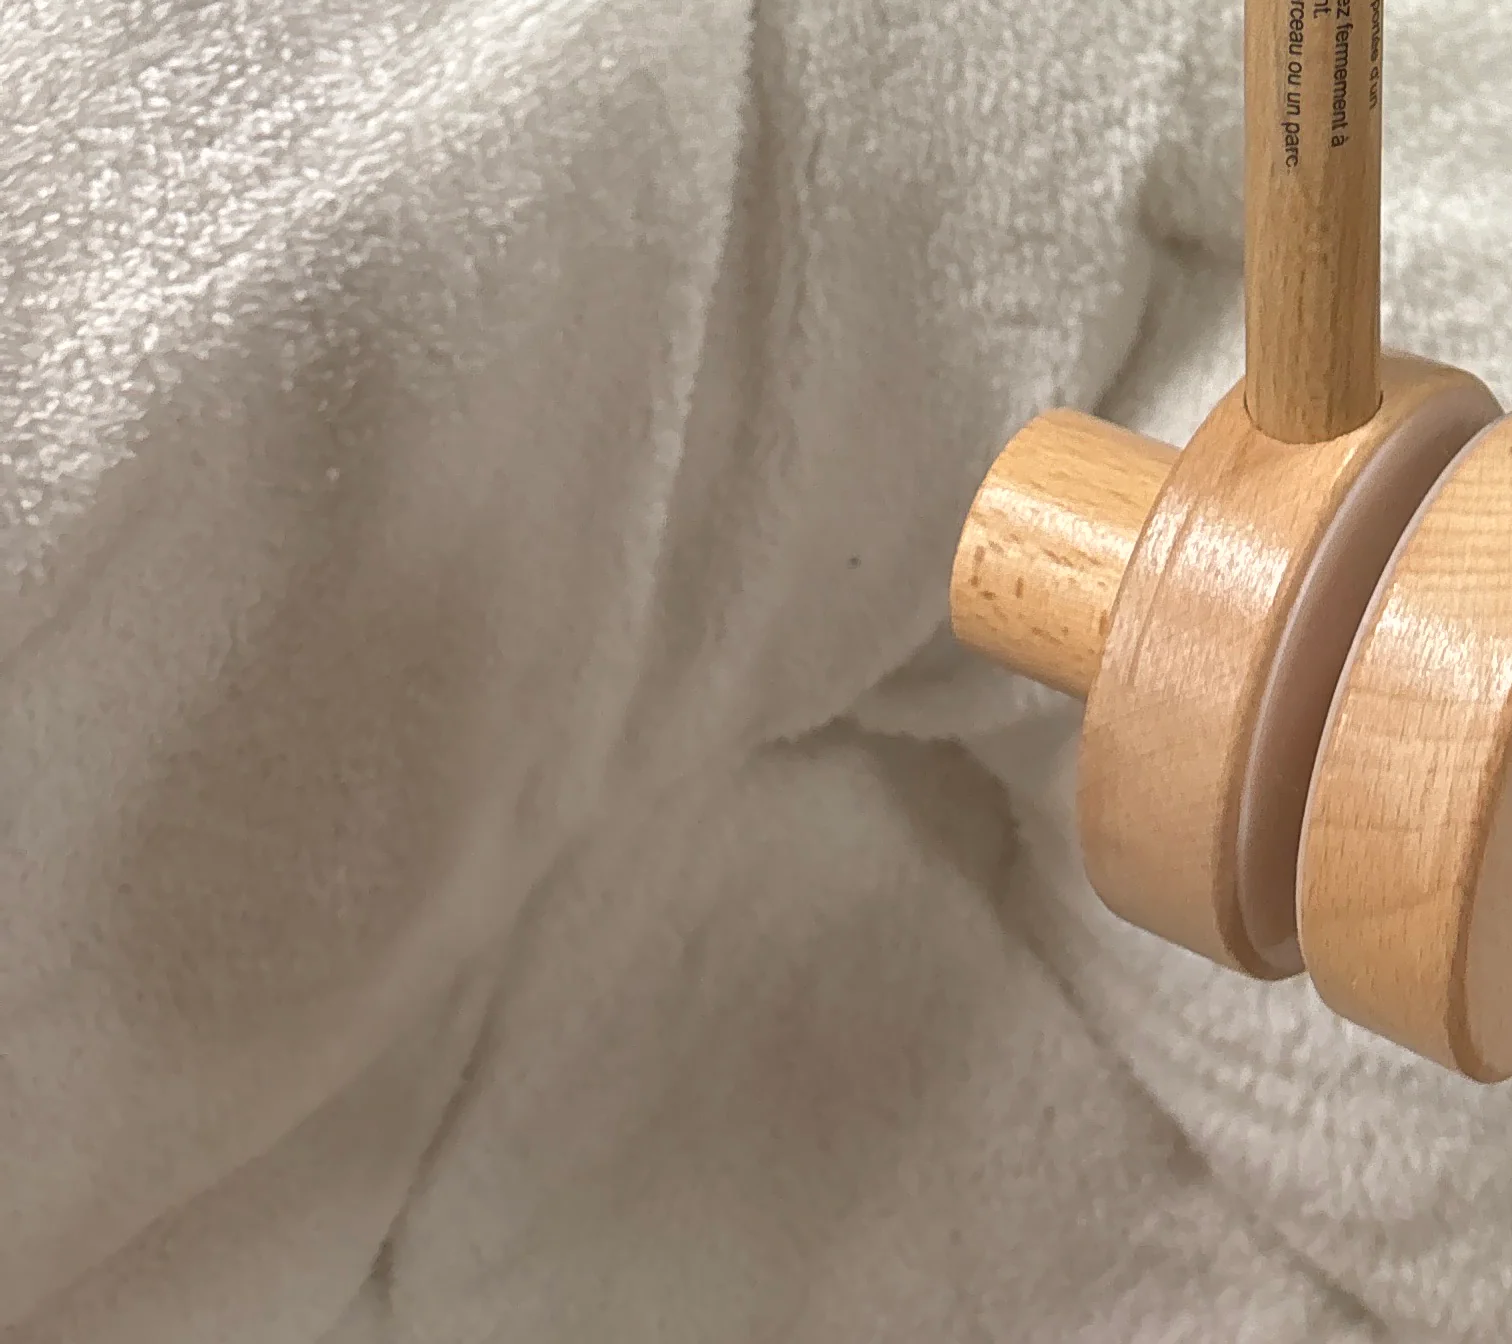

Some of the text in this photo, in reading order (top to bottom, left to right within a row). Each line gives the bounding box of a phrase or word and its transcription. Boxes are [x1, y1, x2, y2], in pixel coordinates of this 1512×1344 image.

[1286, 61, 1302, 86] ou
[1331, 23, 1353, 131] fermement
[1285, 92, 1301, 116] un
[1330, 135, 1349, 148] à
